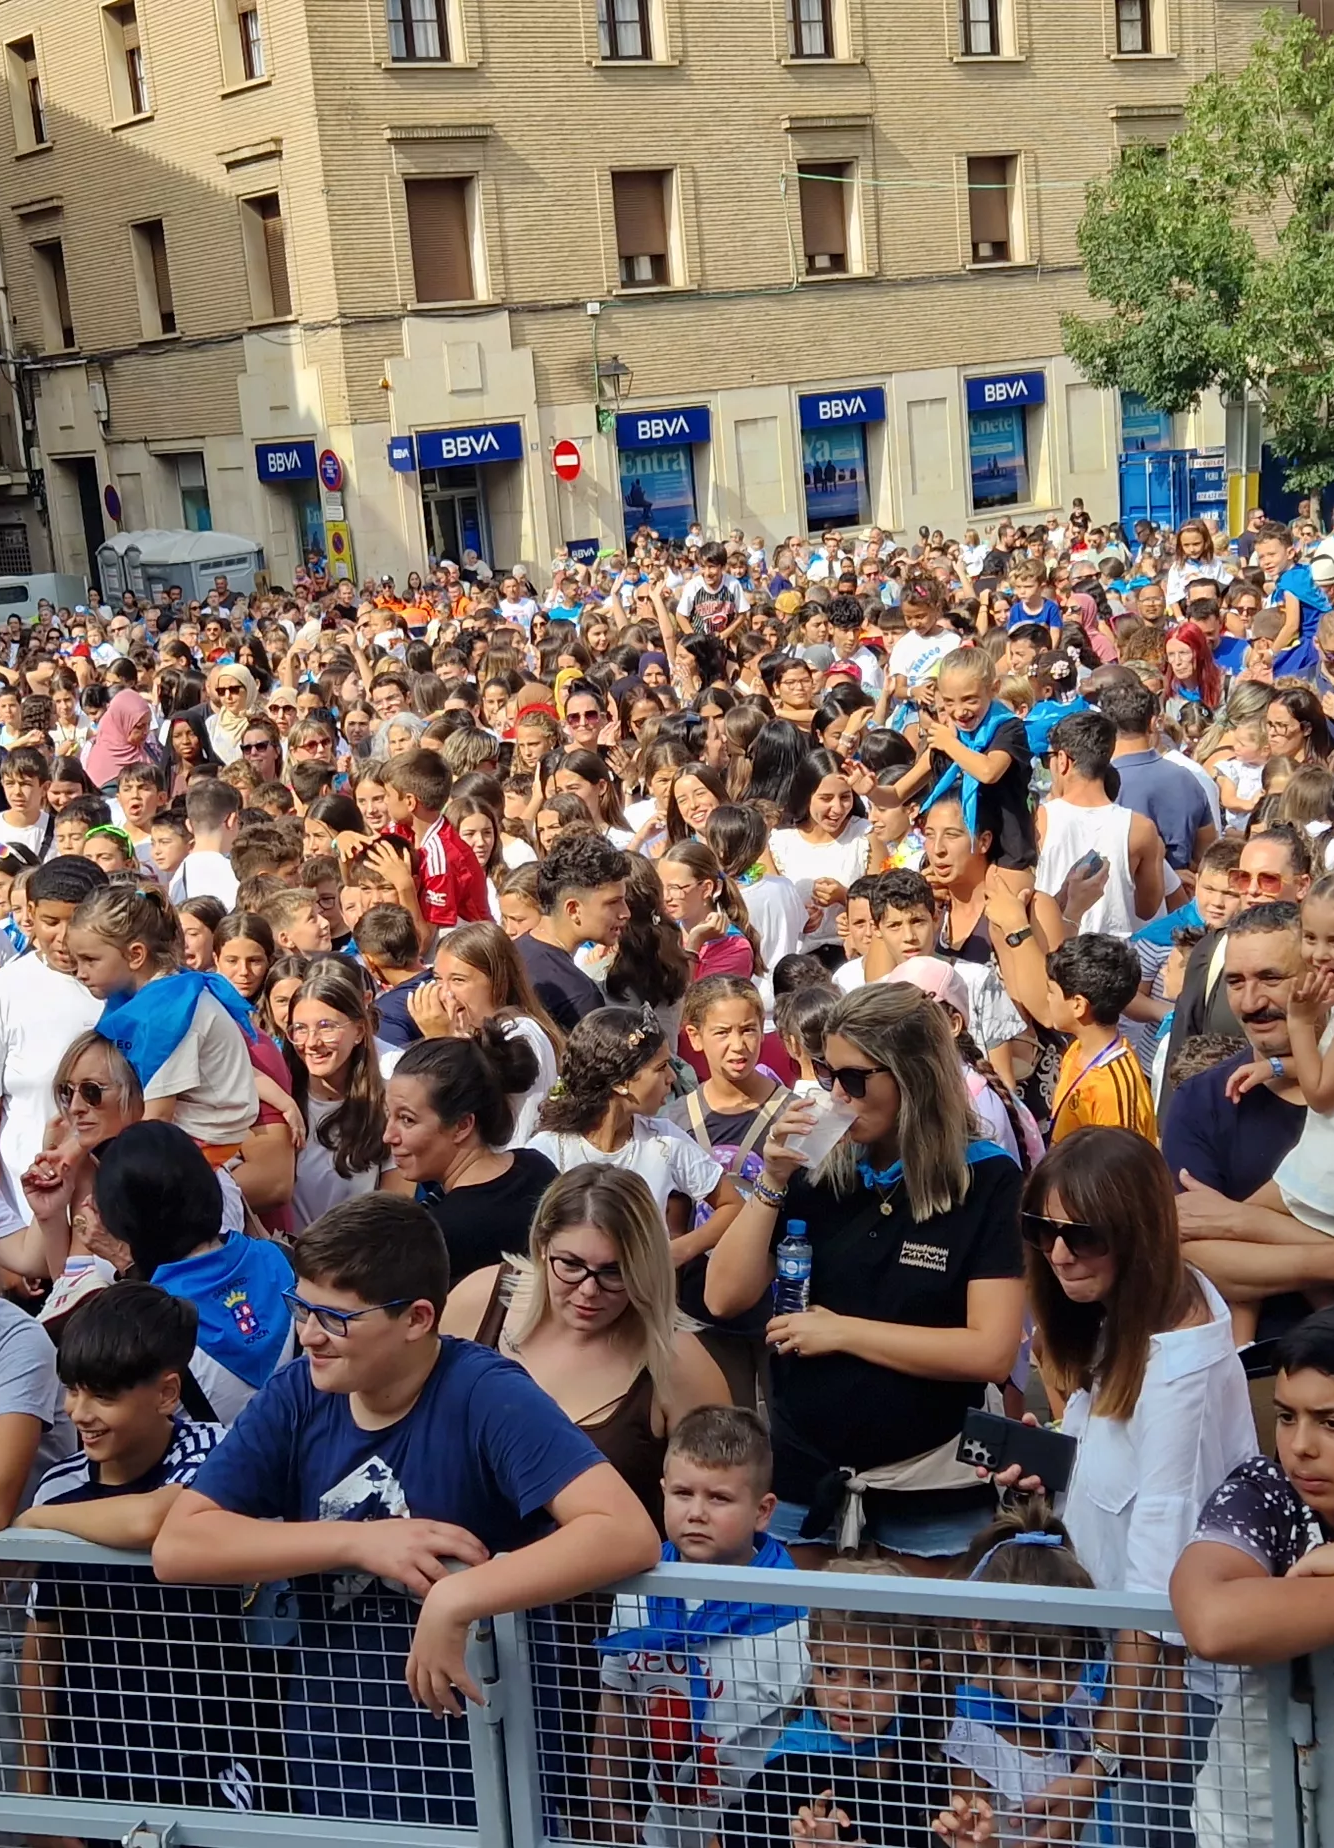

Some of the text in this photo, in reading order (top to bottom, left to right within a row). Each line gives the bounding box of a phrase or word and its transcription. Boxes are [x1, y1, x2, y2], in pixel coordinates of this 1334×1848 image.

[984, 379, 1028, 402] BBVA
[819, 396, 867, 420] BBVA
[638, 415, 690, 440] BBVA
[393, 448, 410, 459] BBVA
[441, 431, 500, 458] BBVA
[268, 449, 301, 472] BBVA
[620, 450, 687, 476] Entra
[571, 547, 595, 561] BBVA
